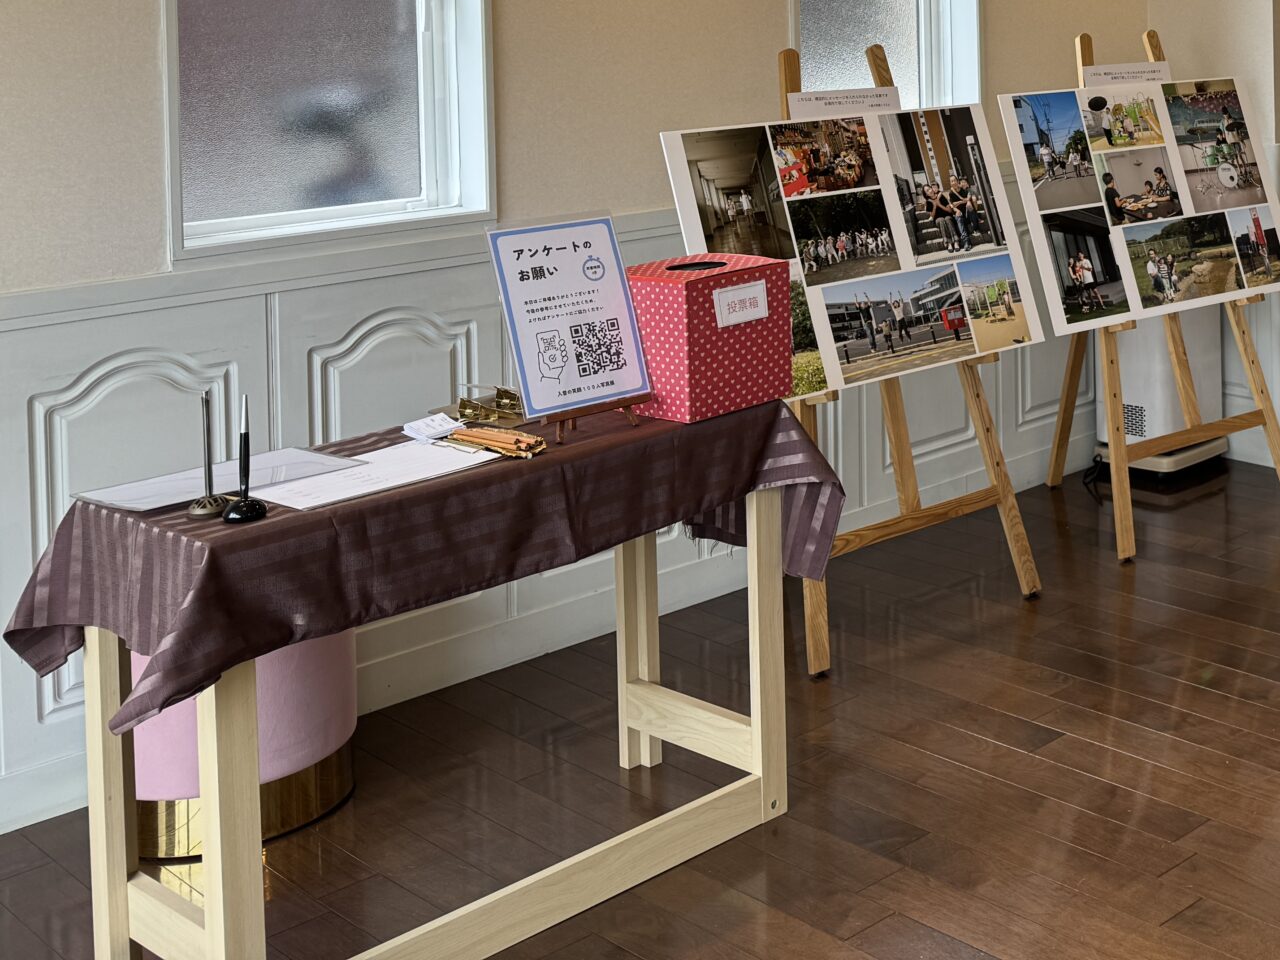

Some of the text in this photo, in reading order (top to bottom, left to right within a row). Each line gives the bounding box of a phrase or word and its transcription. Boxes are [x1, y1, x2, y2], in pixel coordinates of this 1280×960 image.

[513, 241, 592, 261] アンケートの
[518, 265, 558, 282] お願い
[726, 296, 760, 315] 投票箱
